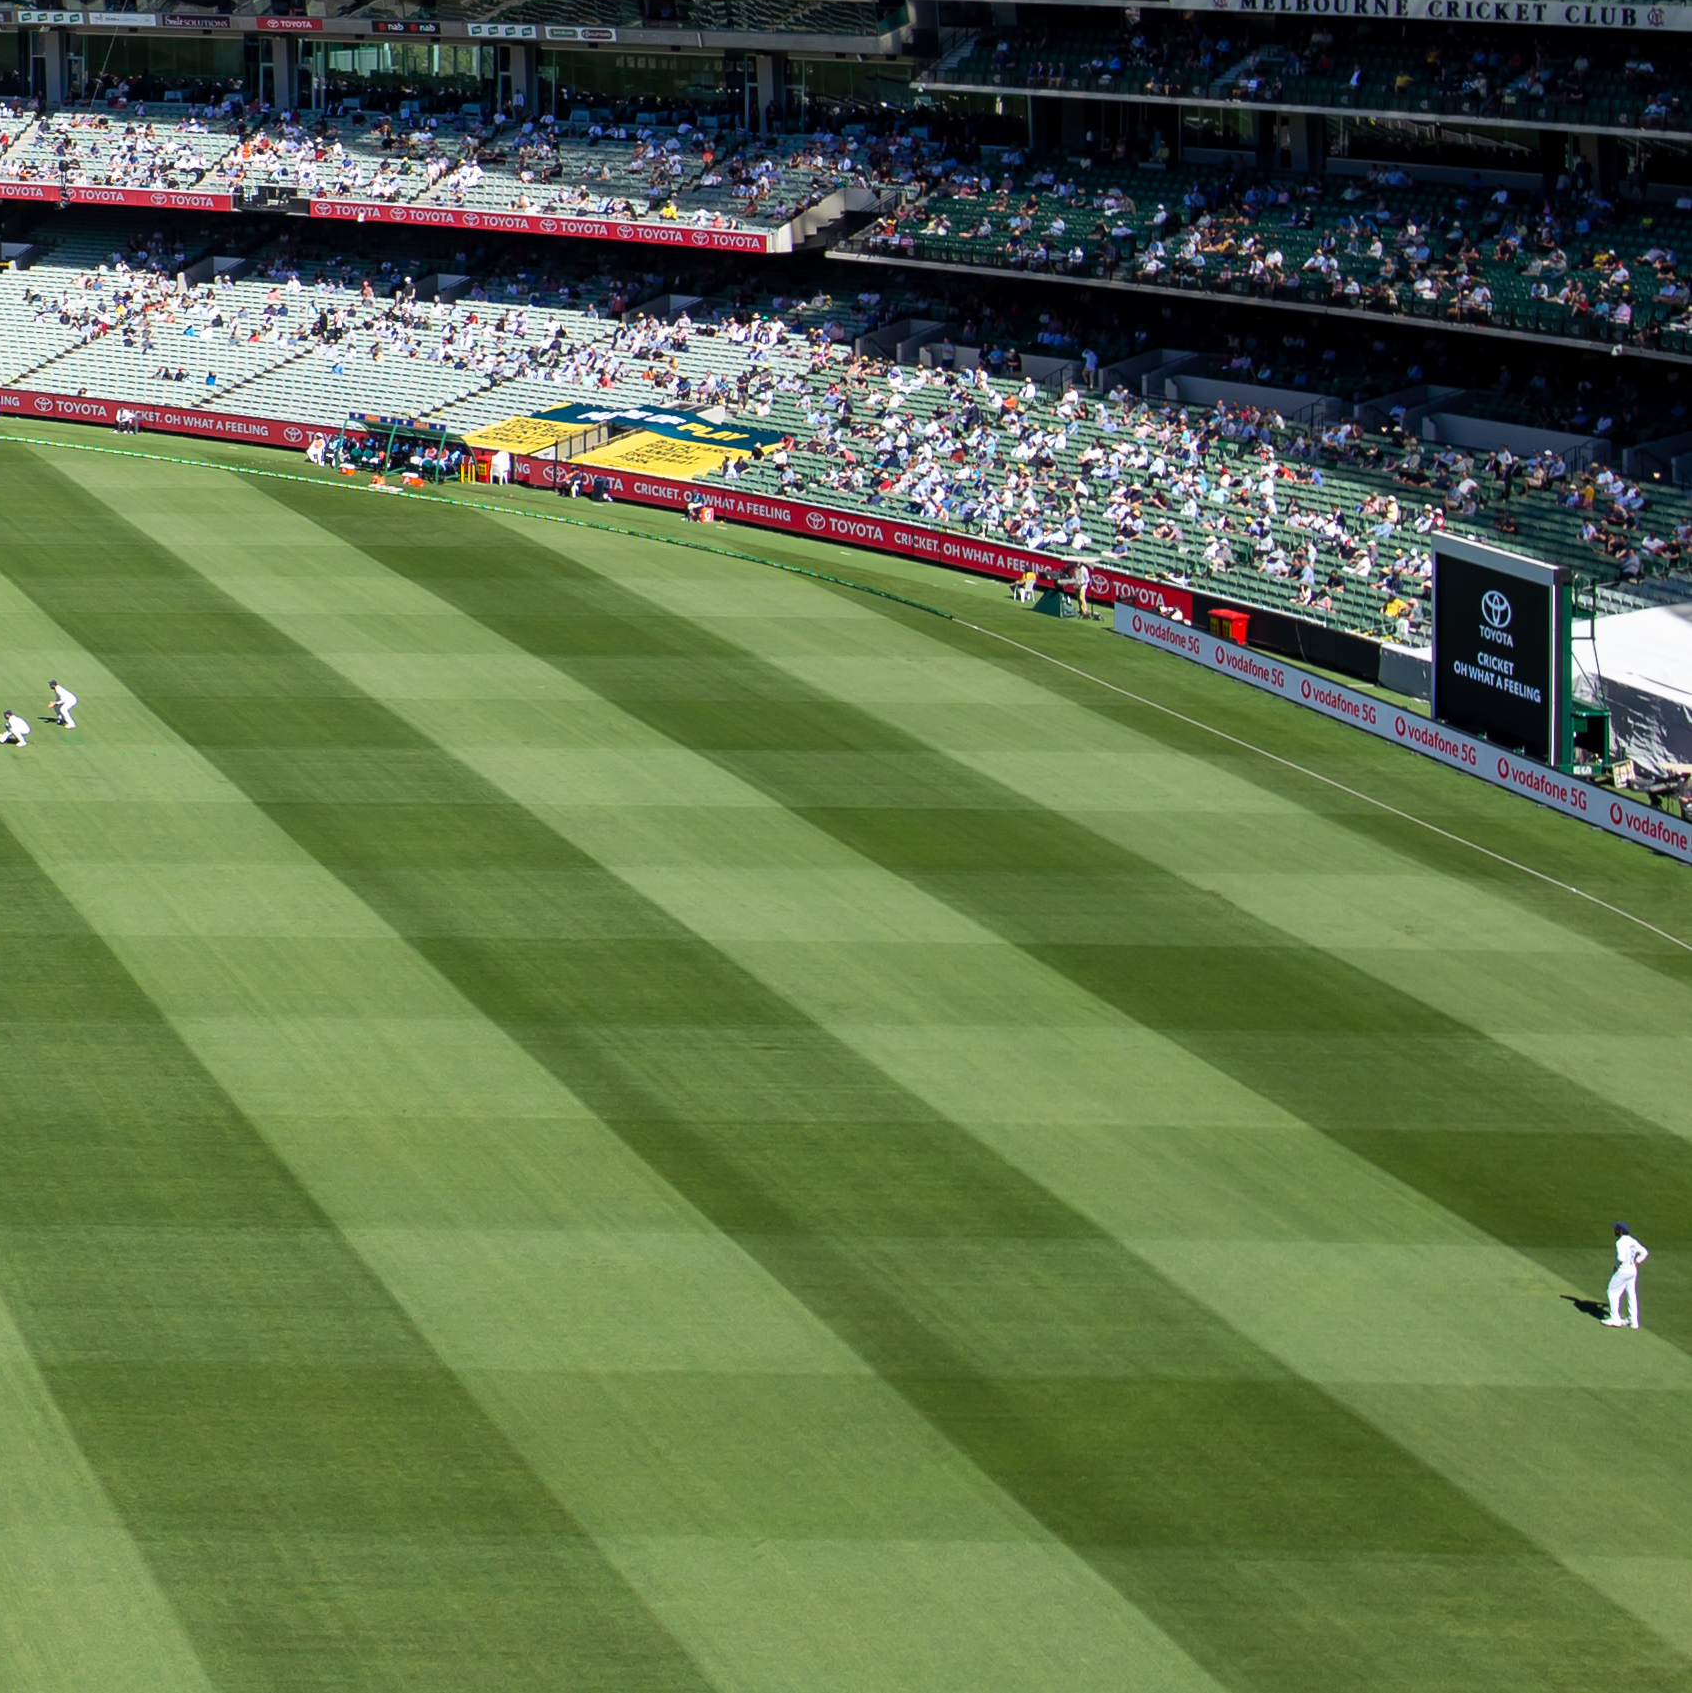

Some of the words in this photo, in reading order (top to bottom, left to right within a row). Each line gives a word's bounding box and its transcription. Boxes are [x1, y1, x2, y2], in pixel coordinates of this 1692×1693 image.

[183, 19, 227, 28] SOLUTIONS
[1565, 4, 1638, 26] CLUB
[56, 401, 106, 416] TOYOTA
[677, 423, 749, 441] PLAY
[829, 518, 883, 540] TOYOTA
[894, 531, 940, 553] CRICKET.
[943, 543, 960, 556] OH
[962, 547, 995, 564] WHAT
[997, 556, 1005, 566] A
[1144, 622, 1185, 648] vodafone
[1188, 637, 1200, 654] 5G
[1479, 624, 1513, 648] TOYOTA
[1226, 653, 1269, 681] vodafone
[1271, 668, 1284, 688] 5G
[1477, 652, 1514, 676] CRICKET
[1454, 660, 1467, 676] OH
[1469, 665, 1494, 687] WHAT
[1496, 674, 1503, 689] A
[1504, 678, 1541, 704] FEELING
[1313, 686, 1359, 717] vodafone
[1362, 704, 1376, 725] 5G
[1408, 725, 1458, 758] vodafone
[1461, 744, 1476, 765] 5G
[1511, 766, 1567, 803] vodafone
[1571, 788, 1587, 810] 5G
[1626, 811, 1687, 850] vodafone
